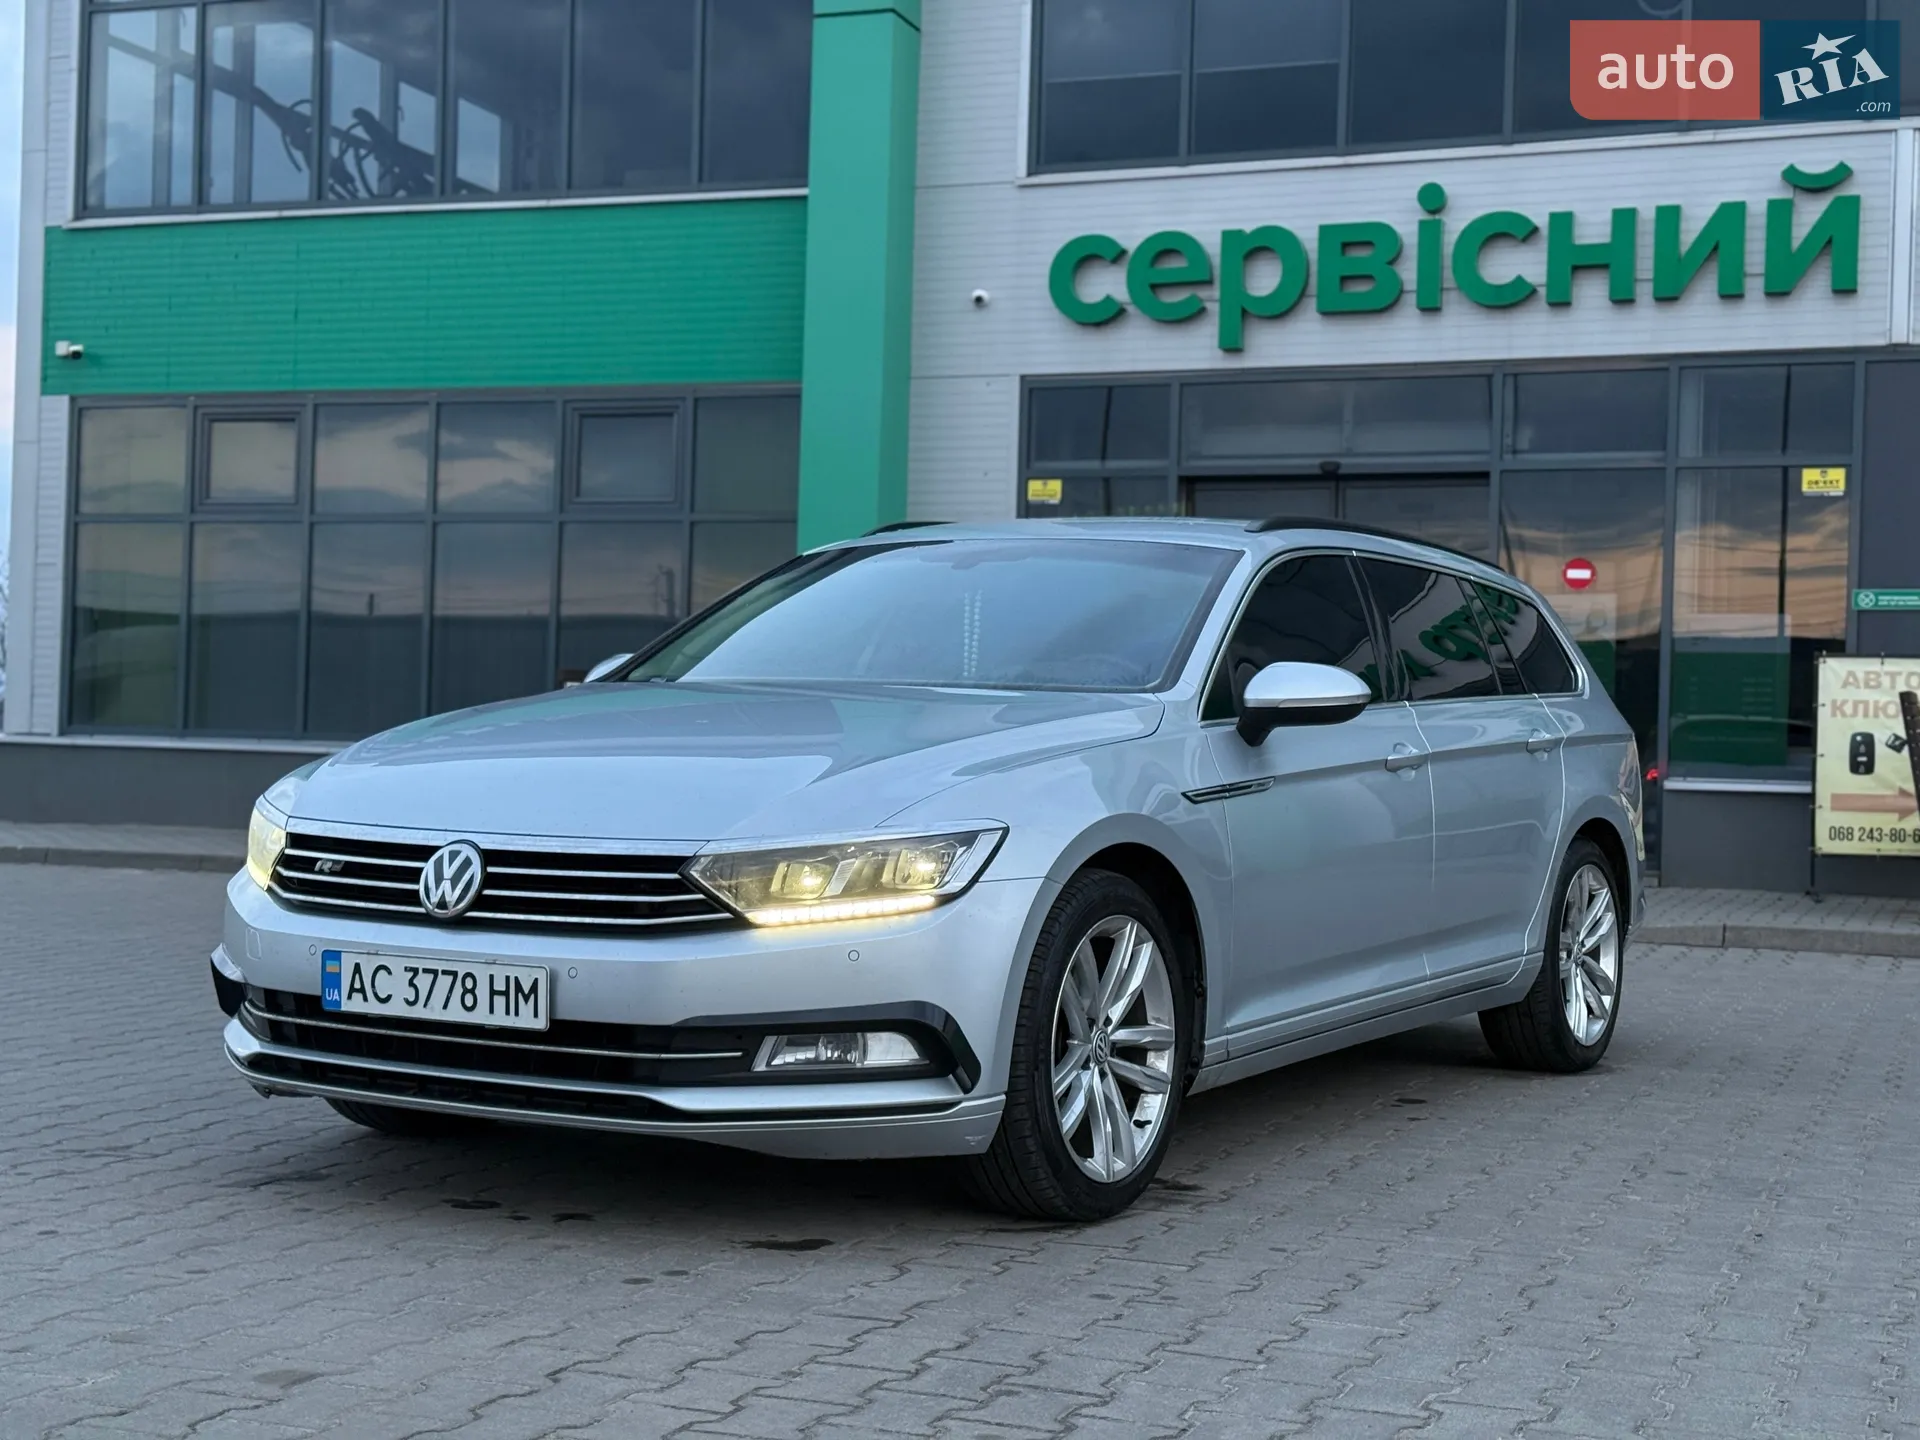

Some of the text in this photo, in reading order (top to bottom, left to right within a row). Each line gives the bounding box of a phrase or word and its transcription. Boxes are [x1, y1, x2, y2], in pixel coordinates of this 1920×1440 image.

[1048, 160, 1862, 353] сервісний
[1840, 670, 1920, 690] АВТО
[1828, 825, 1920, 844] 068 243-80-6
[325, 987, 340, 1002] UA
[346, 961, 539, 1019] AC 3778 HM
